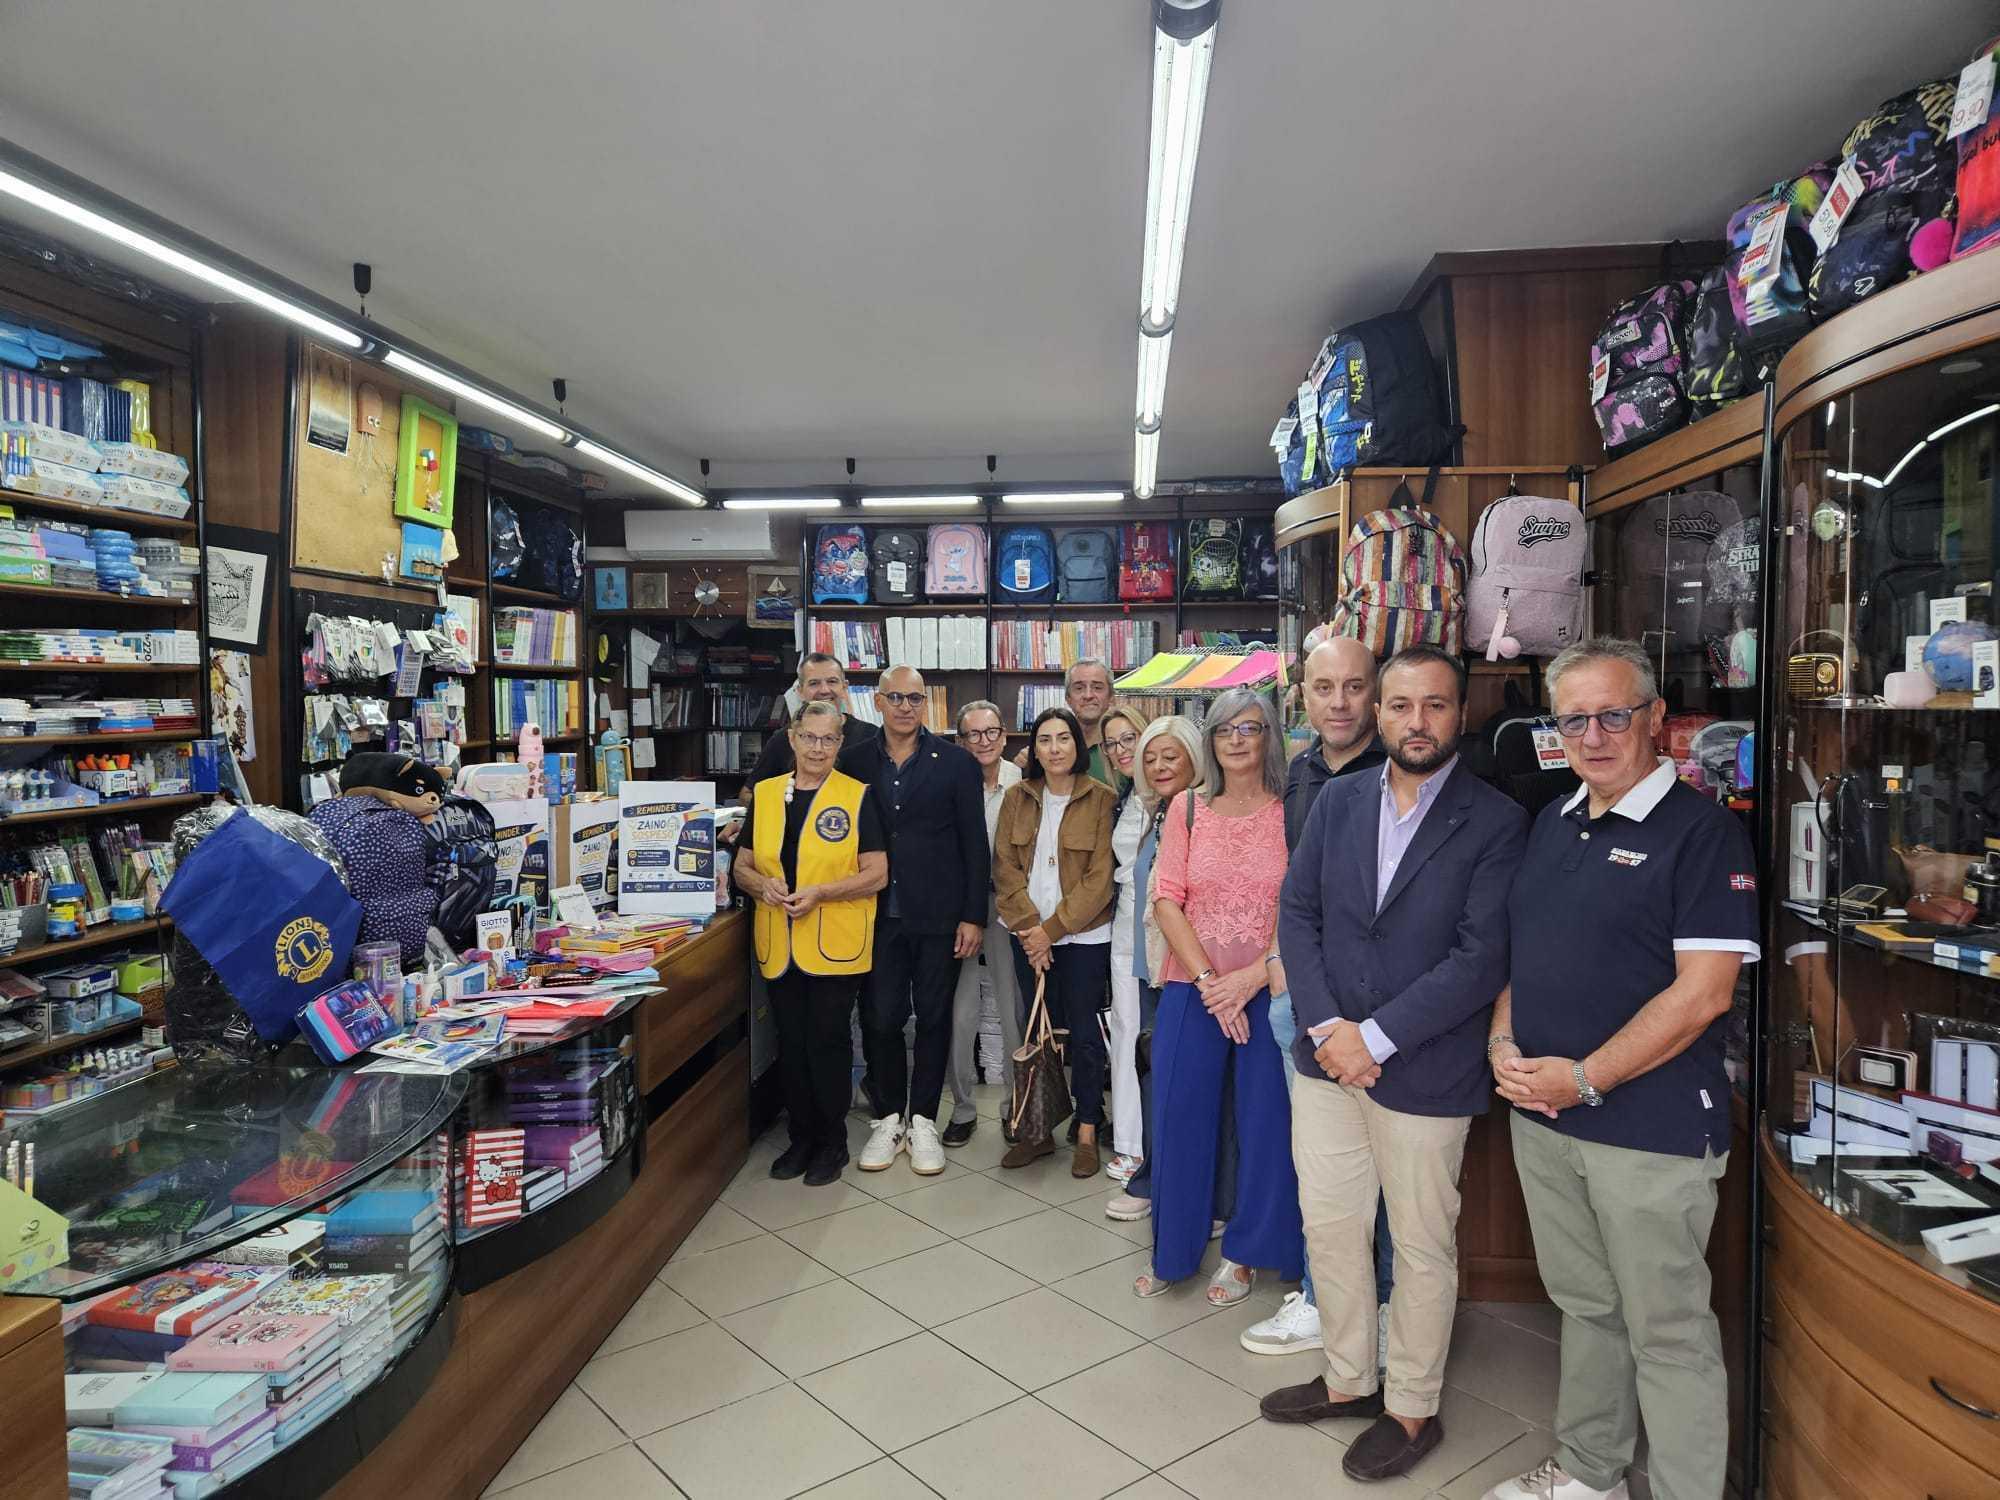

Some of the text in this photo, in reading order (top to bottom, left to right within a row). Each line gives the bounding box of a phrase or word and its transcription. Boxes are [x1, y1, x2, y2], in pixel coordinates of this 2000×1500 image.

[1519, 515, 1570, 543] Swipe
[636, 803, 677, 815] REMINDER
[636, 820, 666, 830] ZAINO
[495, 826, 520, 840] MINDER
[481, 917, 509, 927] GIOTTO
[277, 917, 311, 949] LIONS
[295, 938, 320, 963] L
